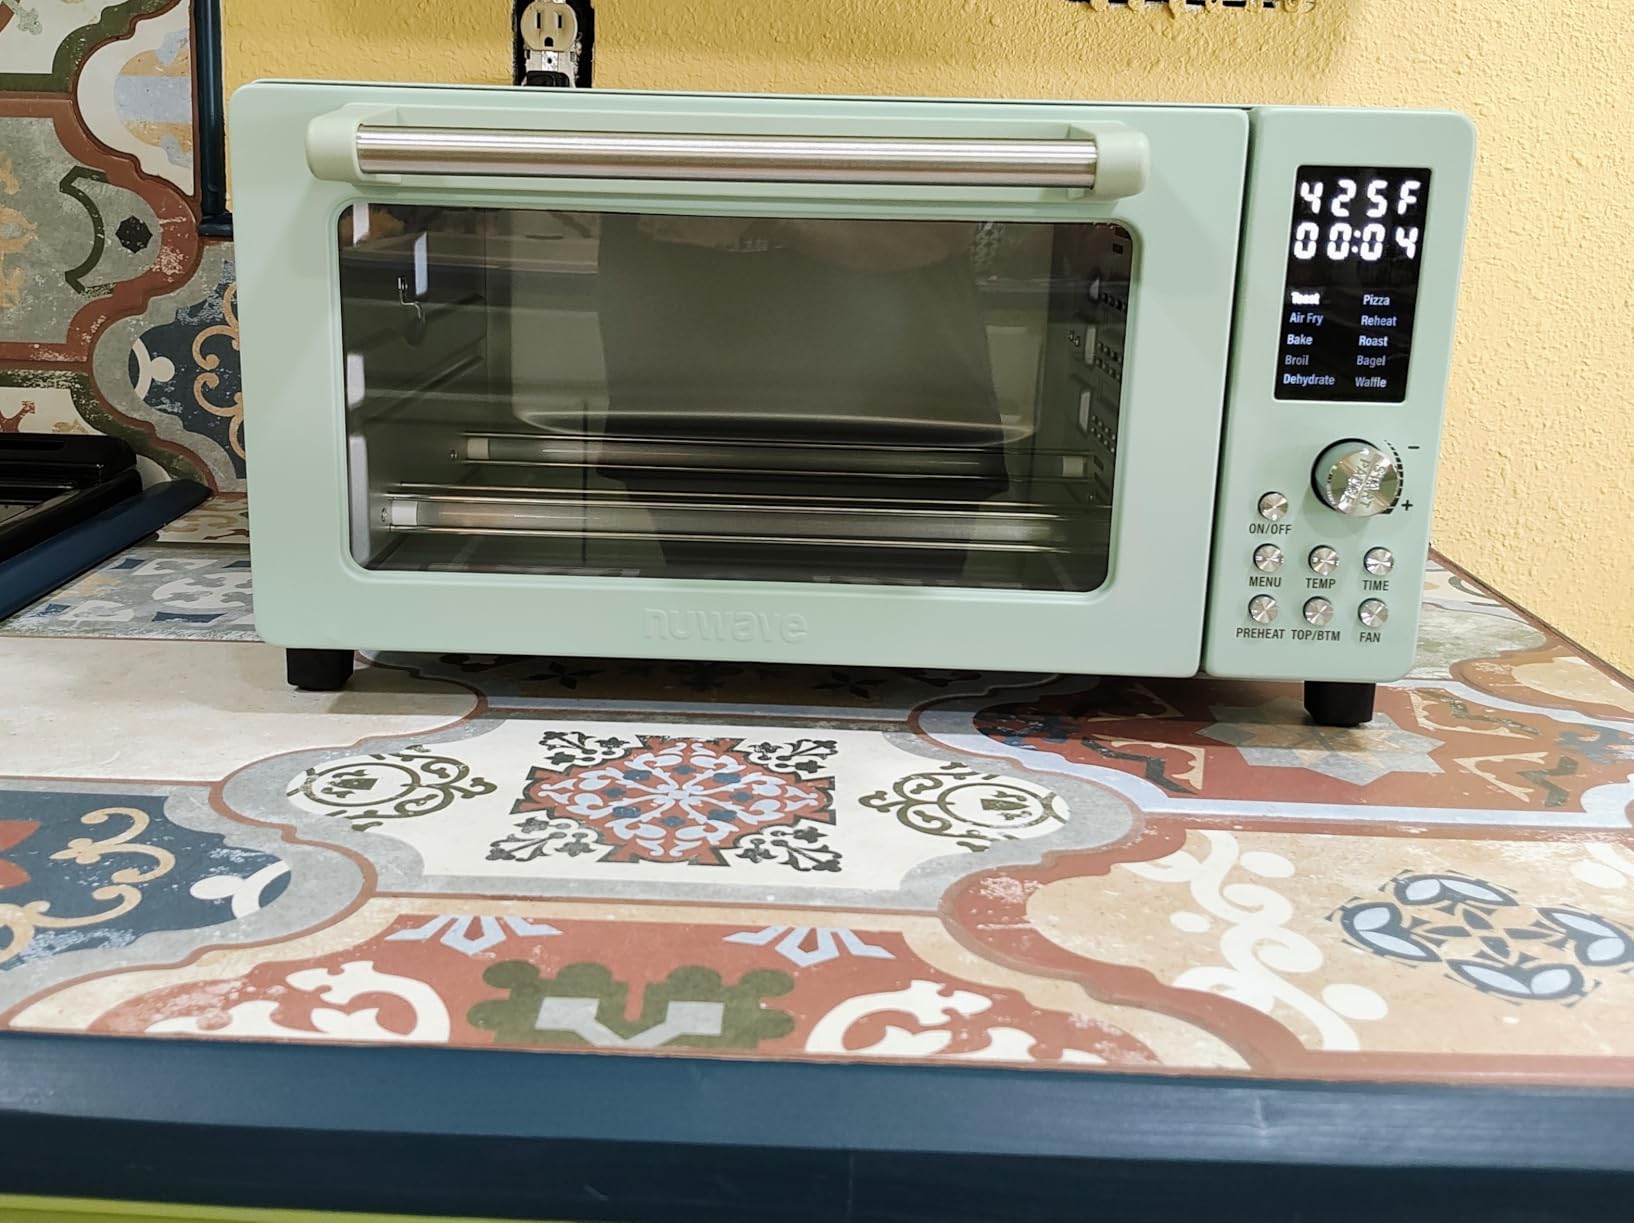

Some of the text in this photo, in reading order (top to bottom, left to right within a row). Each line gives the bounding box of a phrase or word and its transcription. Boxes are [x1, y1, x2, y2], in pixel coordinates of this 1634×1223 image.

[1362, 294, 1390, 306] Pizza
[1289, 312, 1324, 326] Air Fry
[1360, 315, 1397, 327] Reheat
[1286, 334, 1313, 345] Bake
[1358, 336, 1388, 347] Roast
[1284, 354, 1309, 366] Broil
[1356, 355, 1386, 368] Bagel
[1282, 373, 1335, 387] Dehydrate
[1355, 376, 1387, 388] Waffle
[1248, 523, 1292, 535] ON/OFF
[1249, 576, 1282, 588] MENU
[1305, 577, 1336, 589] TEMP
[1362, 579, 1390, 591] TIME
[643, 606, 809, 644] nuwave
[1235, 627, 1286, 640] PREHEAT
[1291, 629, 1341, 641] TOP/BTM
[1359, 631, 1381, 643] FAN
